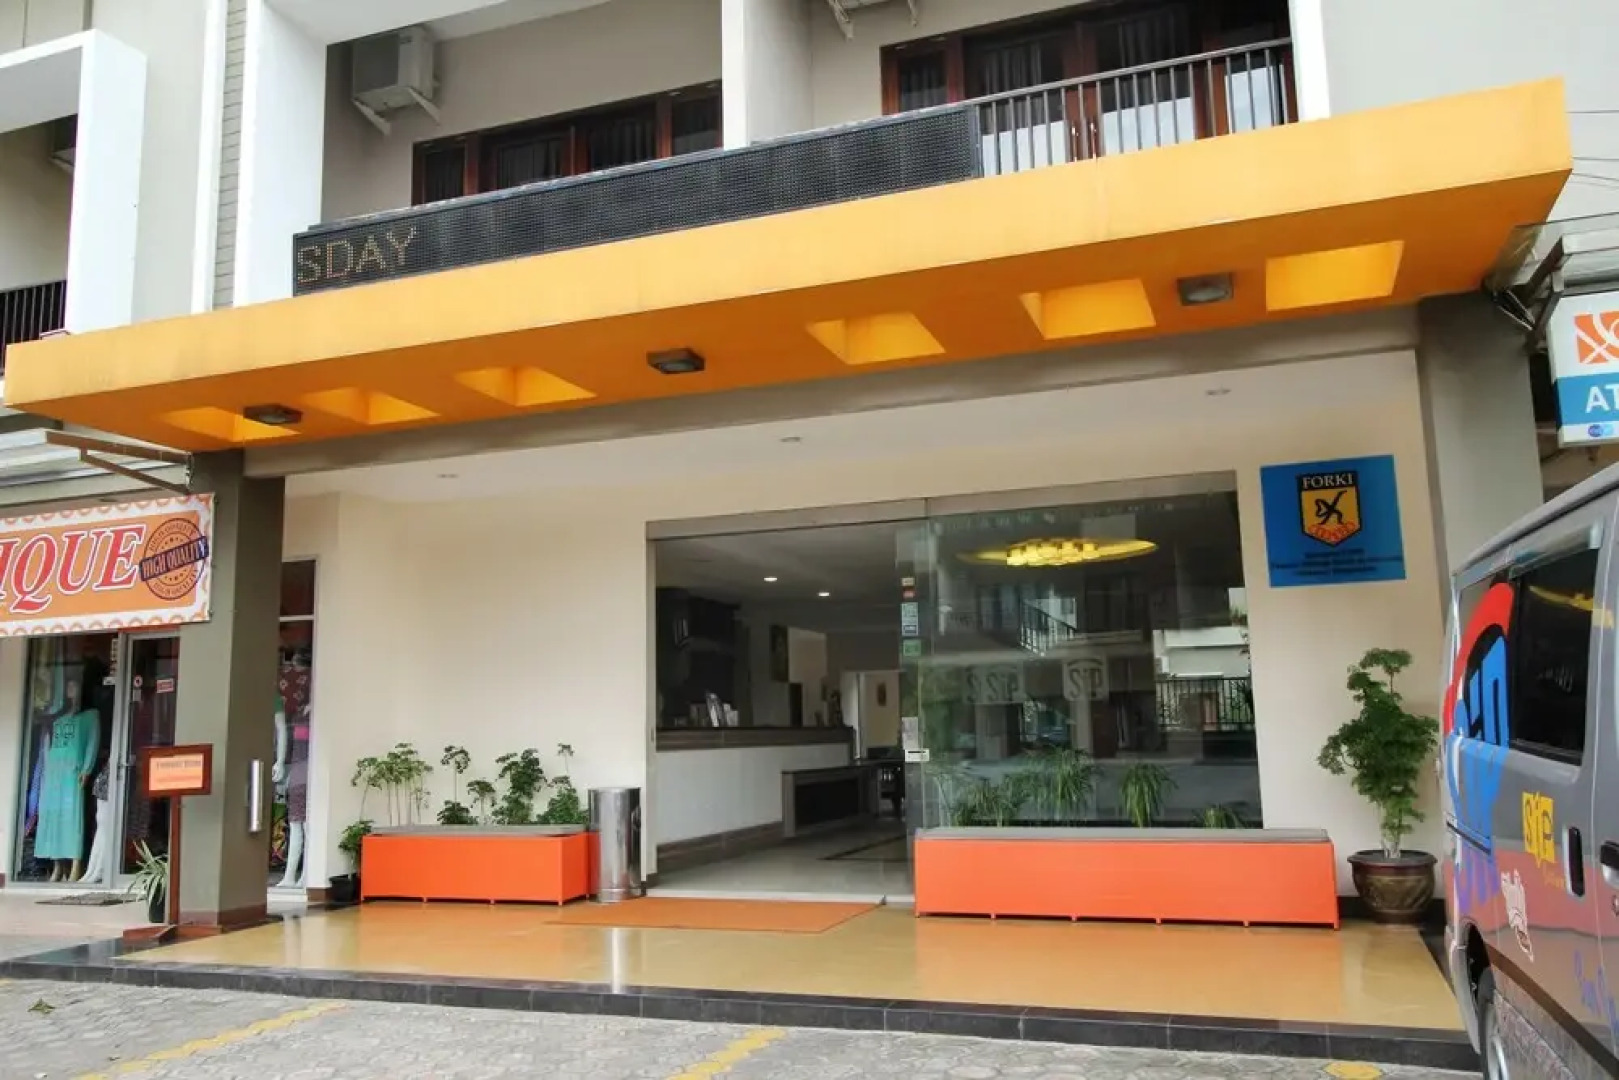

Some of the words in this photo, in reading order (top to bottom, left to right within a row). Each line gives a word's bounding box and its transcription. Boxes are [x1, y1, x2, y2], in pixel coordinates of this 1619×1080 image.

[297, 226, 417, 283] SDAY
[1302, 473, 1354, 489] FORKI
[141, 553, 167, 579] HIGH
[166, 538, 206, 568] QUALITY
